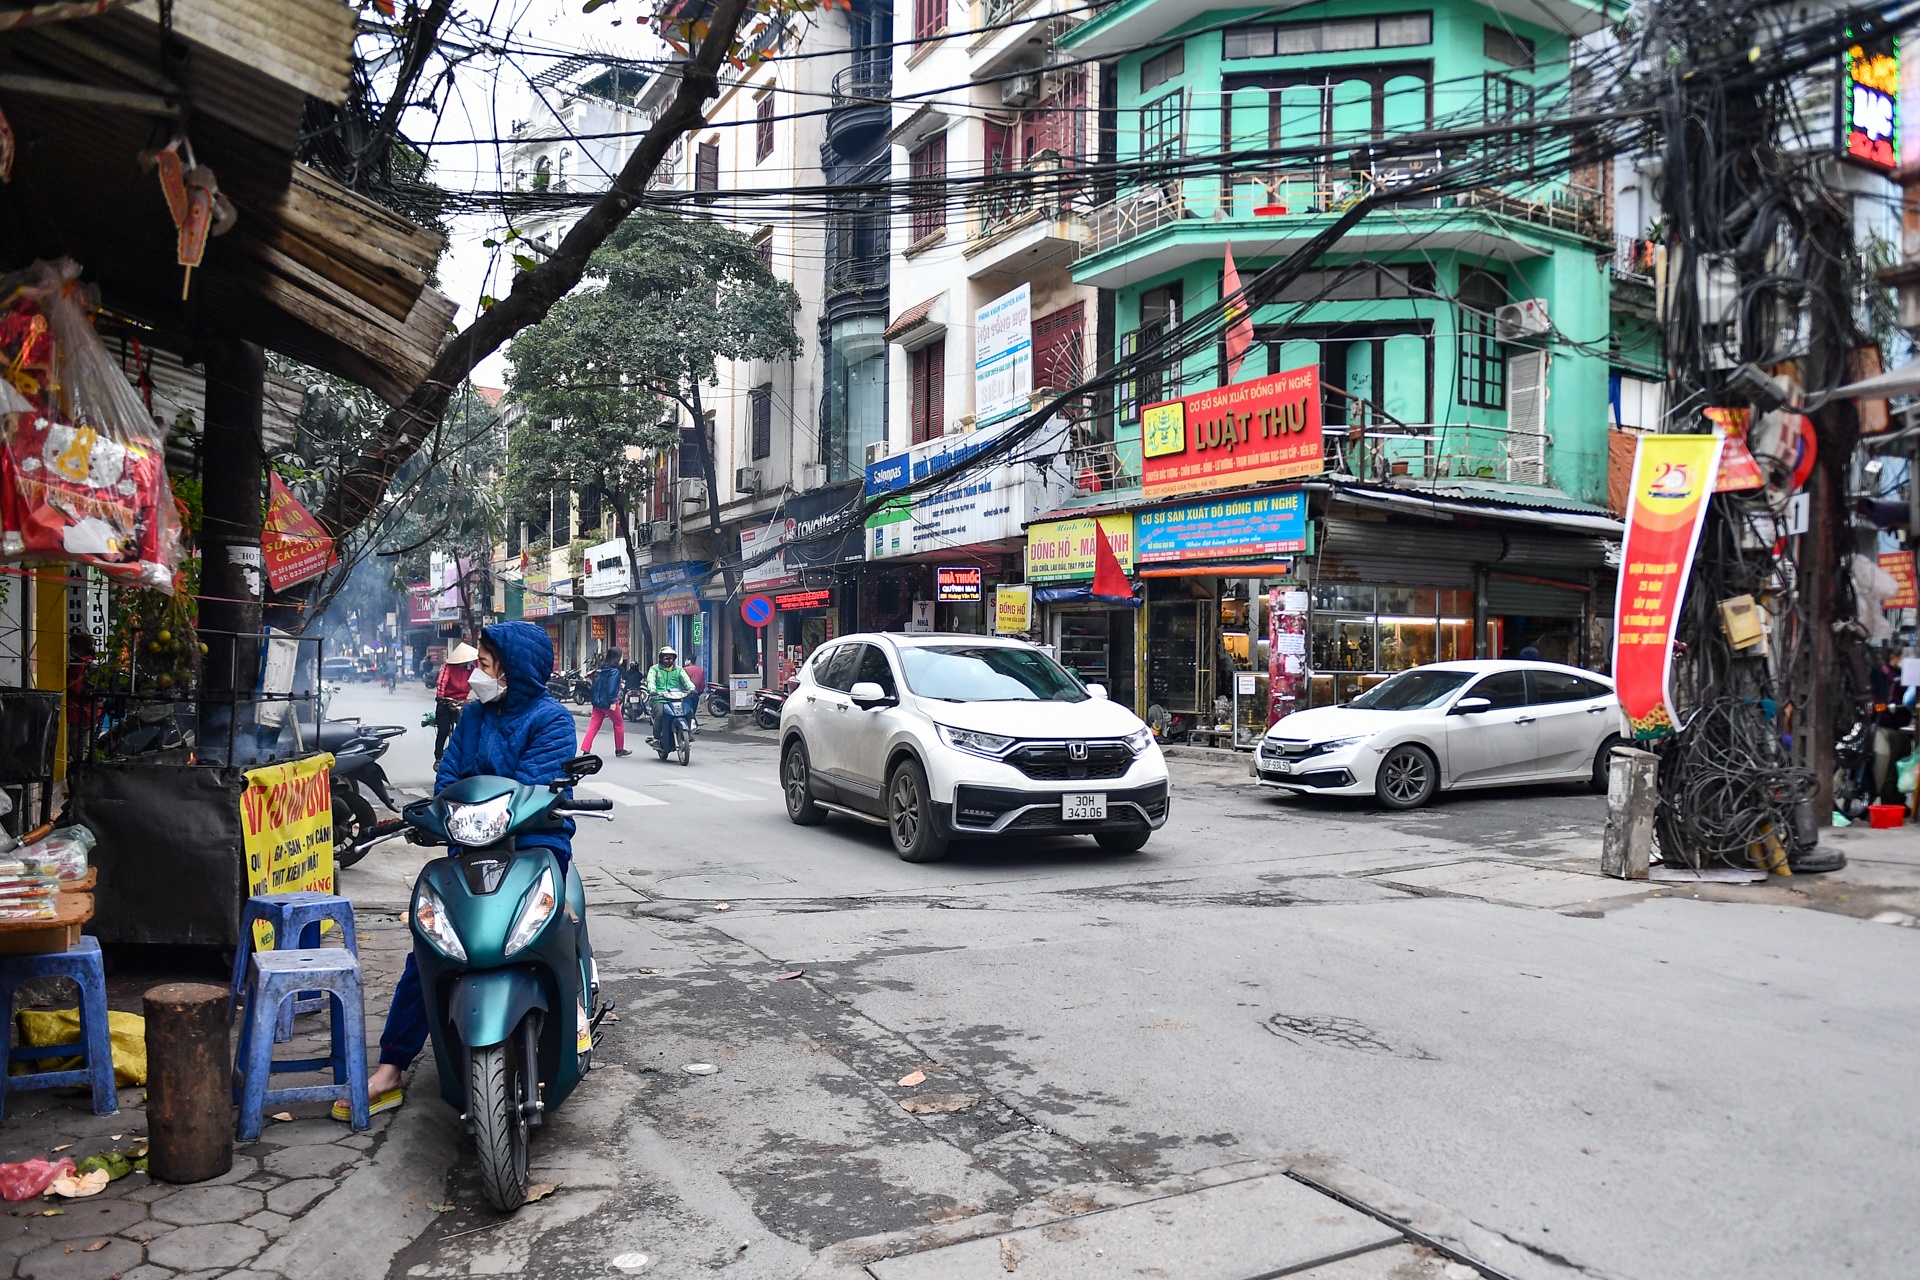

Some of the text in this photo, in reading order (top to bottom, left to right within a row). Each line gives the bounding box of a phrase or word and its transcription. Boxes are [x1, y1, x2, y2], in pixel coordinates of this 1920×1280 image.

[1190, 400, 1200, 413] CƠ
[1230, 386, 1249, 404] XUẤT
[1250, 381, 1273, 399] ĐỒNG
[1289, 374, 1312, 391] NGHỆ
[1194, 397, 1307, 451] LUẬT THƯ
[874, 465, 901, 484] Salonpas
[1141, 513, 1152, 525] CƠ
[1187, 504, 1209, 520] XUẤT
[1272, 494, 1298, 511] NGHỆ
[276, 548, 298, 562] CÁC
[1031, 537, 1055, 560] ĐỒNG
[1058, 534, 1070, 558] HỒ
[1080, 534, 1096, 556] MÁ
[940, 570, 979, 584] NHÀ THUỐC
[1000, 602, 1026, 615] ĐỒNG HỒ
[1075, 796, 1094, 806] 30H
[1068, 807, 1102, 818] 343.06
